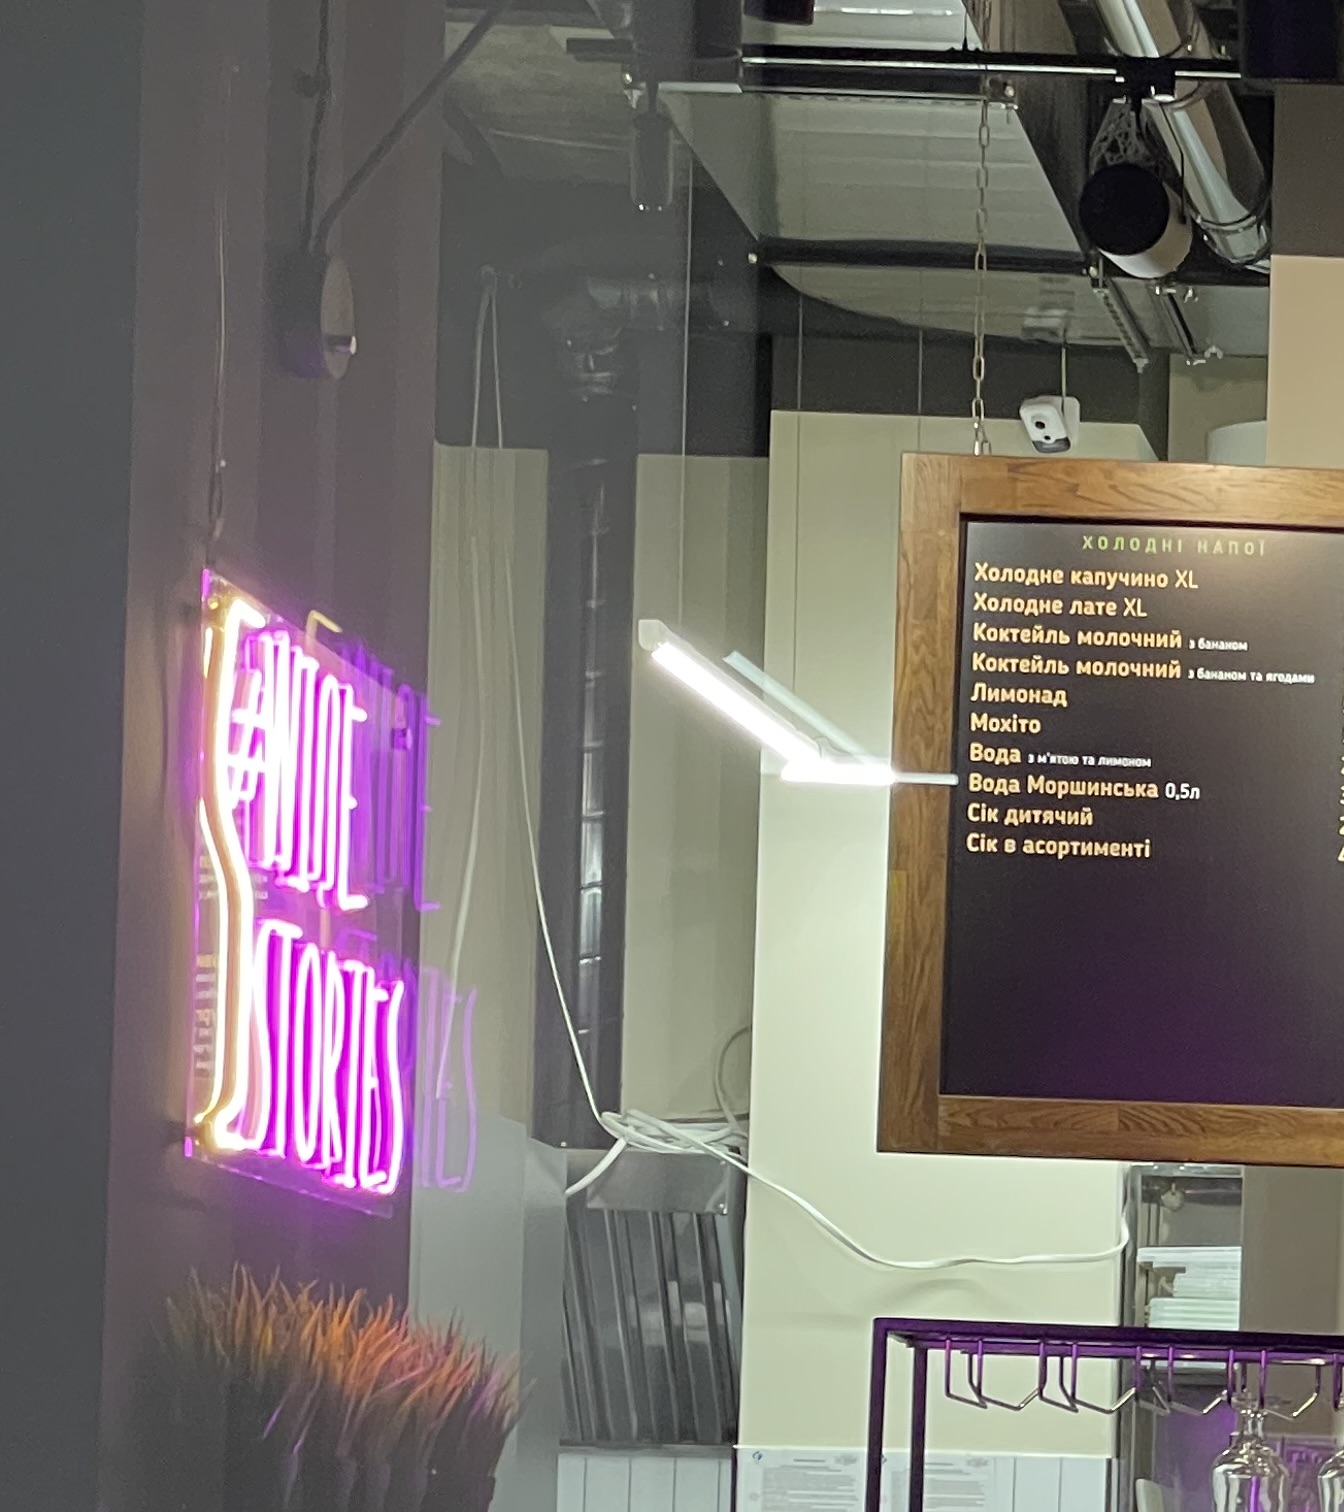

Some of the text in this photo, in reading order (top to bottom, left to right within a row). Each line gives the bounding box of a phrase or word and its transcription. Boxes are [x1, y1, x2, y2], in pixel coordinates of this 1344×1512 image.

[1083, 531, 1265, 556] ХОЛОДНІ НАПОЇ
[975, 562, 1198, 590] Холодне капучино XL
[974, 622, 1070, 644] Коктейль
[1078, 630, 1181, 648] молочний
[1198, 638, 1247, 650] бананом
[973, 652, 1069, 674] Коктейль
[1077, 660, 1181, 678] молочний
[1197, 668, 1246, 680] бананом
[1250, 672, 1262, 681] та
[1266, 673, 1314, 684] ягодами
[971, 683, 1067, 707] Лимонад
[971, 713, 1040, 733] Мохіто
[970, 743, 1021, 765] Вода
[1082, 756, 1095, 765] та
[1098, 757, 1151, 767] лимоном
[969, 773, 1200, 800] Вода Моршинська 0,5л
[968, 803, 1092, 826] Сік дитячий
